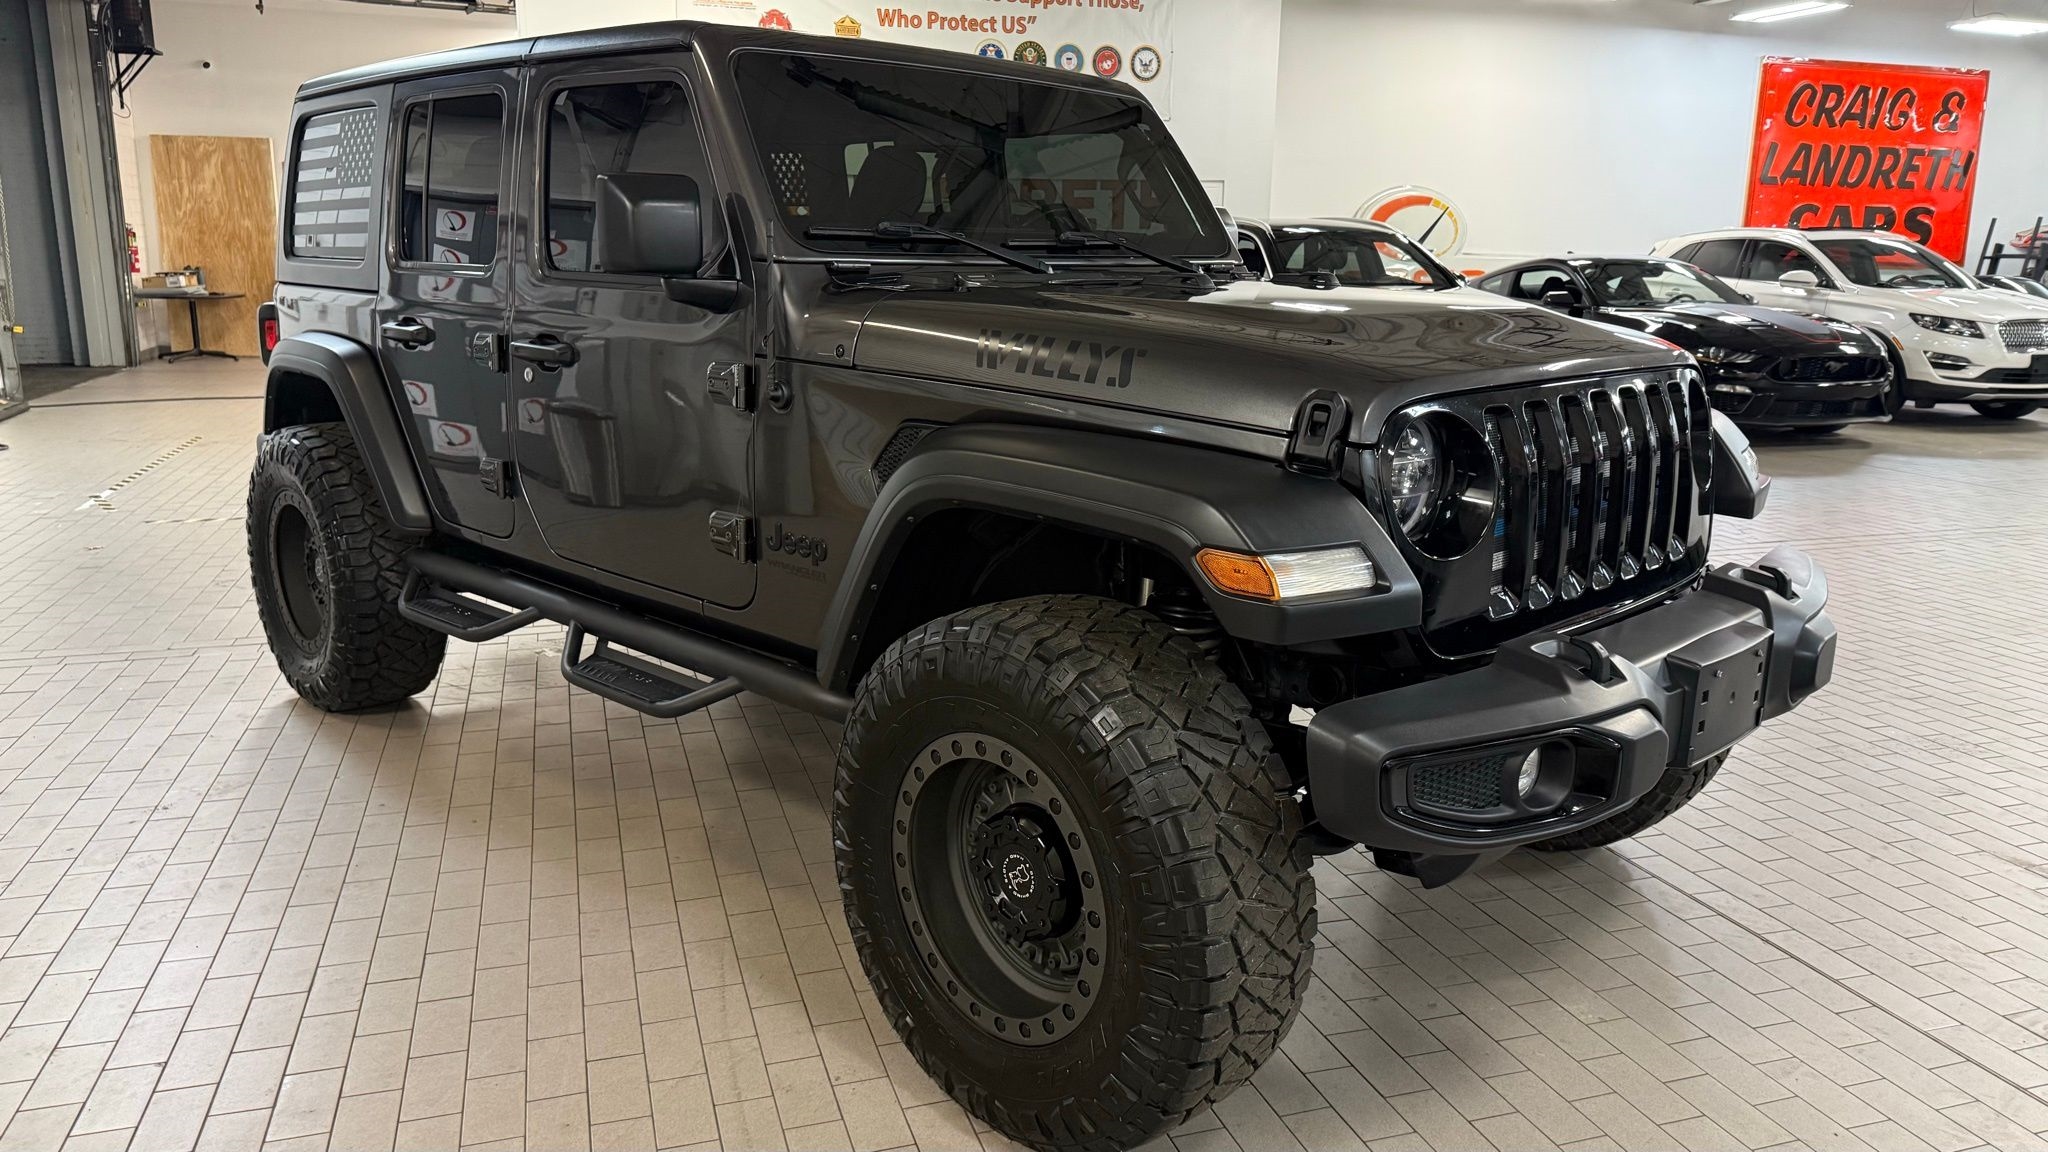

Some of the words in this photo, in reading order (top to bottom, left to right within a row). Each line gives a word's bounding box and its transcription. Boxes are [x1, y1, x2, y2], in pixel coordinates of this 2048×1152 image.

[877, 8, 923, 29] Who
[927, 11, 998, 33] Protect
[1784, 83, 1917, 131] CRAIG
[1932, 90, 1967, 132] &
[1760, 141, 1975, 192] LANDRETH
[975, 327, 1149, 389] WILLYS
[766, 521, 828, 567] Jeep
